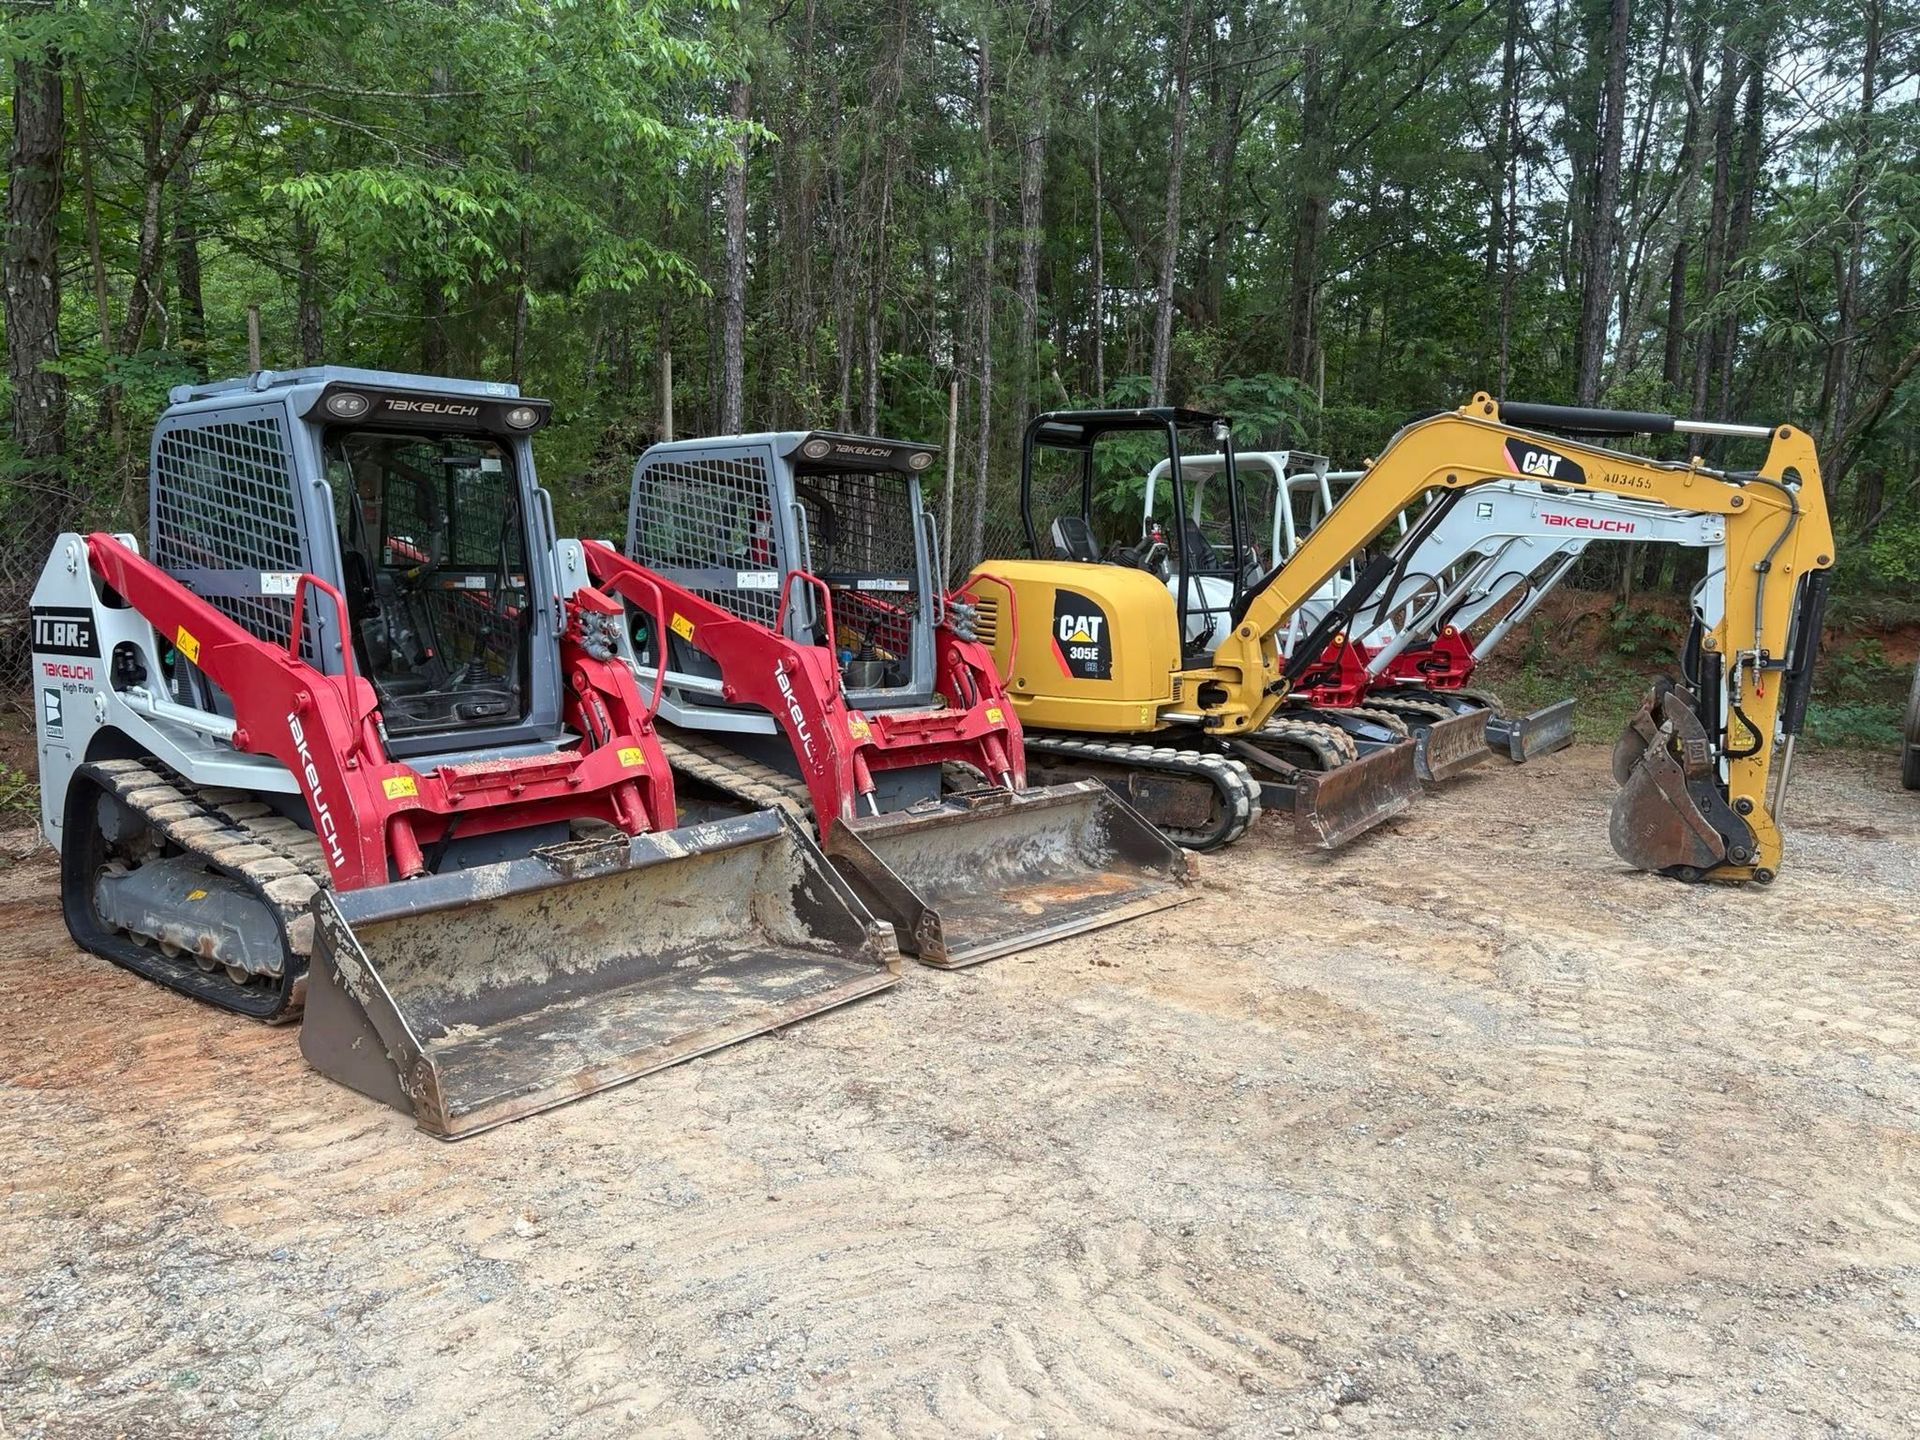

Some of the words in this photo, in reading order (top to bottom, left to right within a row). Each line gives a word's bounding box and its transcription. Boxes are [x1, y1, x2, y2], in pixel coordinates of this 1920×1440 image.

[1522, 451, 1562, 477] CAT
[1060, 614, 1103, 643] CAT
[1070, 646, 1099, 660] 305E
[62, 682, 78, 695] High
[78, 683, 95, 695] Flow
[774, 658, 824, 776] TAKEUC
